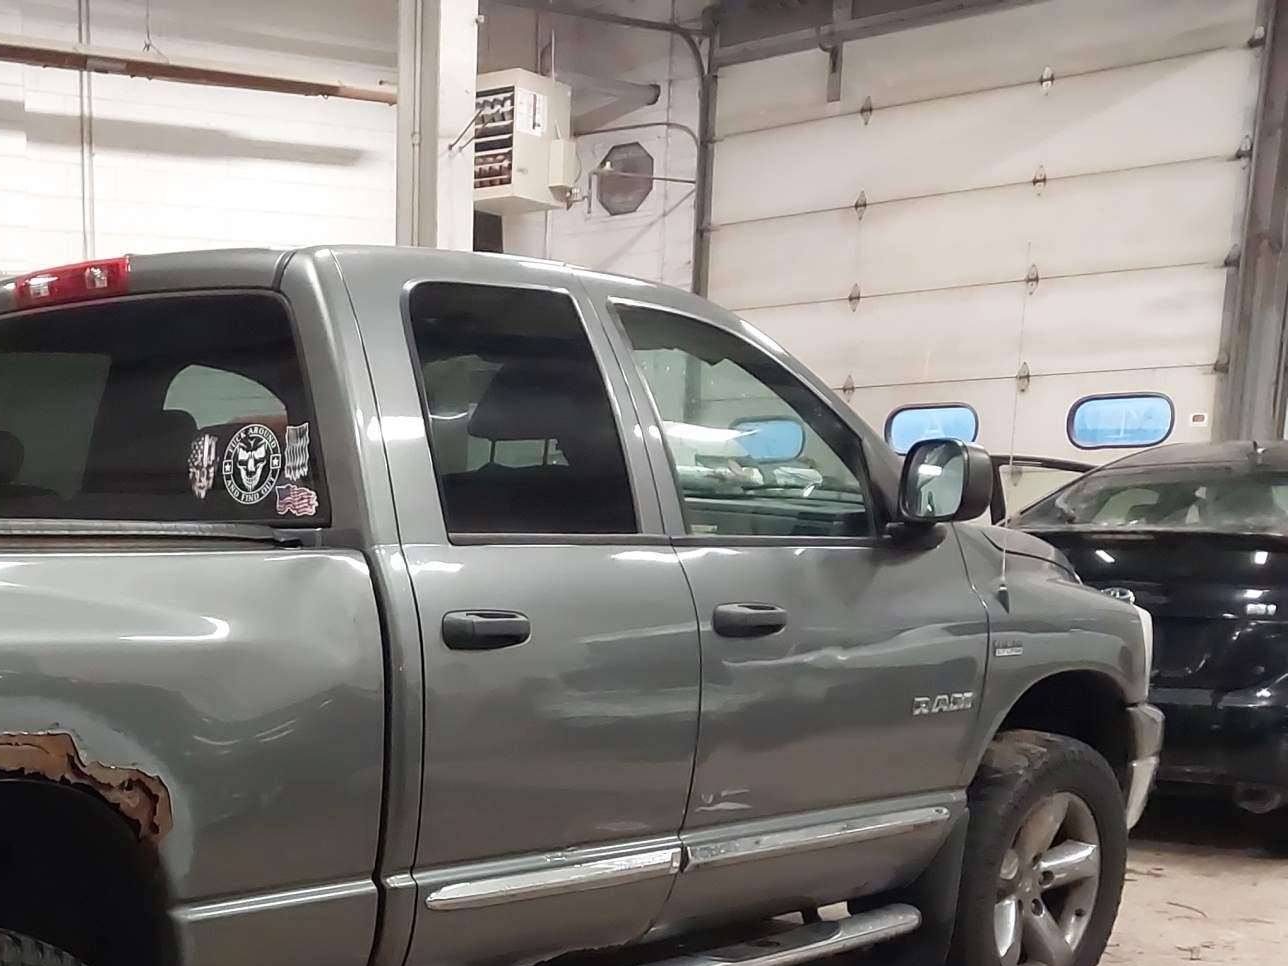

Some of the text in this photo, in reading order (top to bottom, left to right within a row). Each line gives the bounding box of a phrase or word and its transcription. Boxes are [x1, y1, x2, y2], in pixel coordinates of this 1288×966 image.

[228, 426, 277, 453] FUCK AROUND
[226, 477, 276, 502] AND FIND OUT
